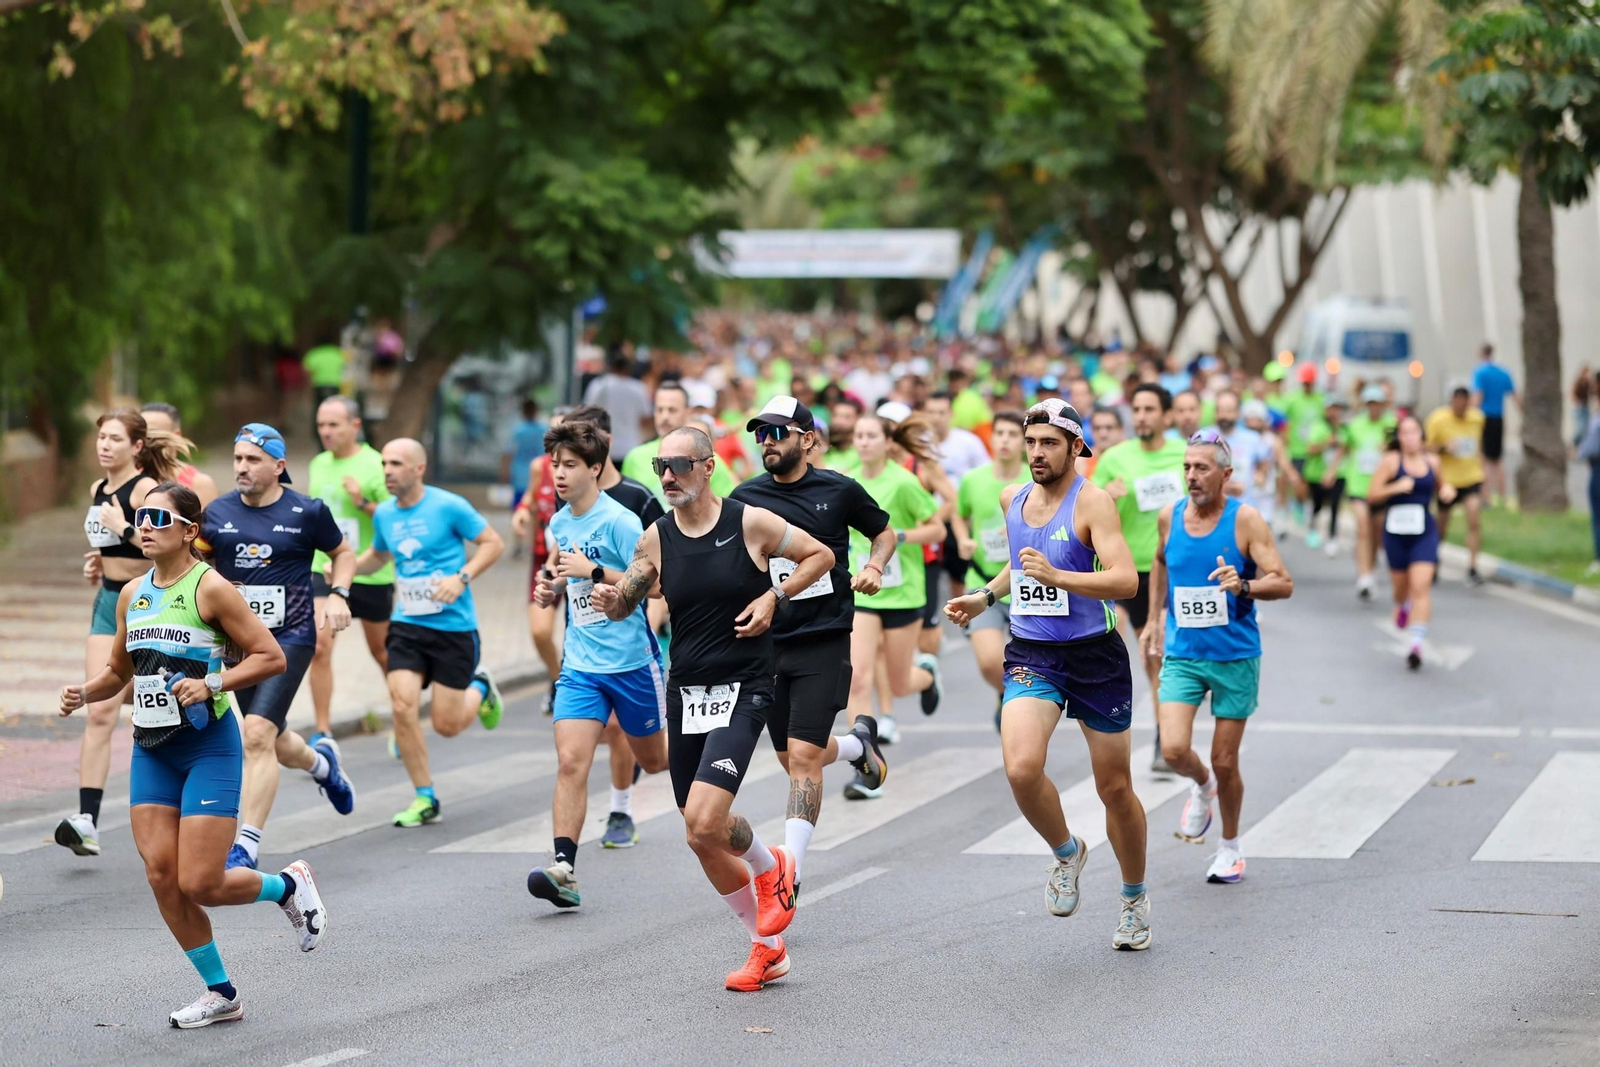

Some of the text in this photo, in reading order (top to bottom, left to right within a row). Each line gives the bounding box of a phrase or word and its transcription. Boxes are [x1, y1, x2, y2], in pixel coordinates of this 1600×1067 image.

[1020, 586, 1058, 601] 549
[1181, 601, 1217, 615] 583
[137, 692, 168, 708] 126
[688, 701, 731, 717] 1183
